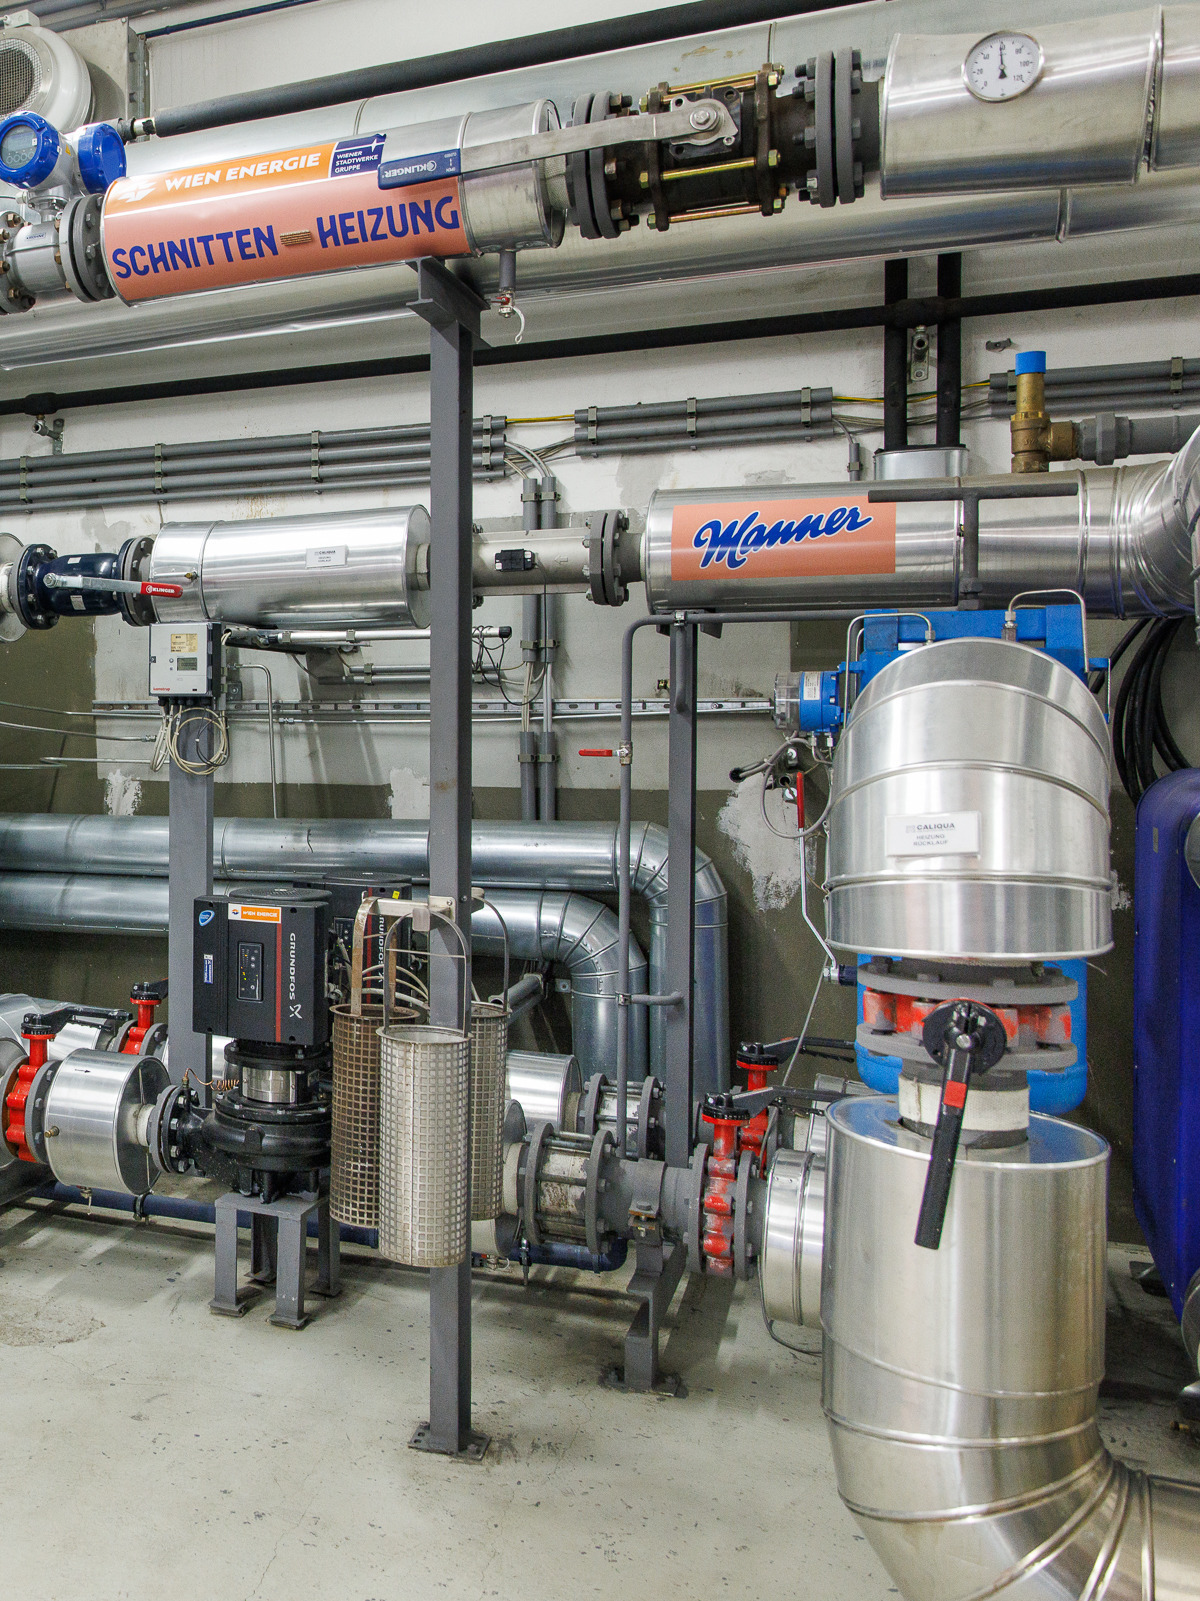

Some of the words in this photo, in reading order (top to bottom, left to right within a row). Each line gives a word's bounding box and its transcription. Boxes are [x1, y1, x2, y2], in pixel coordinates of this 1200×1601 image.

[335, 154, 379, 166] STADTWERKE
[336, 150, 363, 159] WIENER
[164, 169, 222, 192] WIEN
[225, 152, 322, 182] ENERGIE
[334, 164, 361, 173] GRUPPE
[384, 164, 427, 178] KLINGER
[111, 224, 280, 279] SCHNITTEN
[315, 196, 461, 249] HEIZUNG
[693, 506, 873, 570] Manner
[916, 822, 955, 831] CALIQUA
[256, 910, 278, 918] ENERGIE
[378, 913, 386, 966] RUNDFOS
